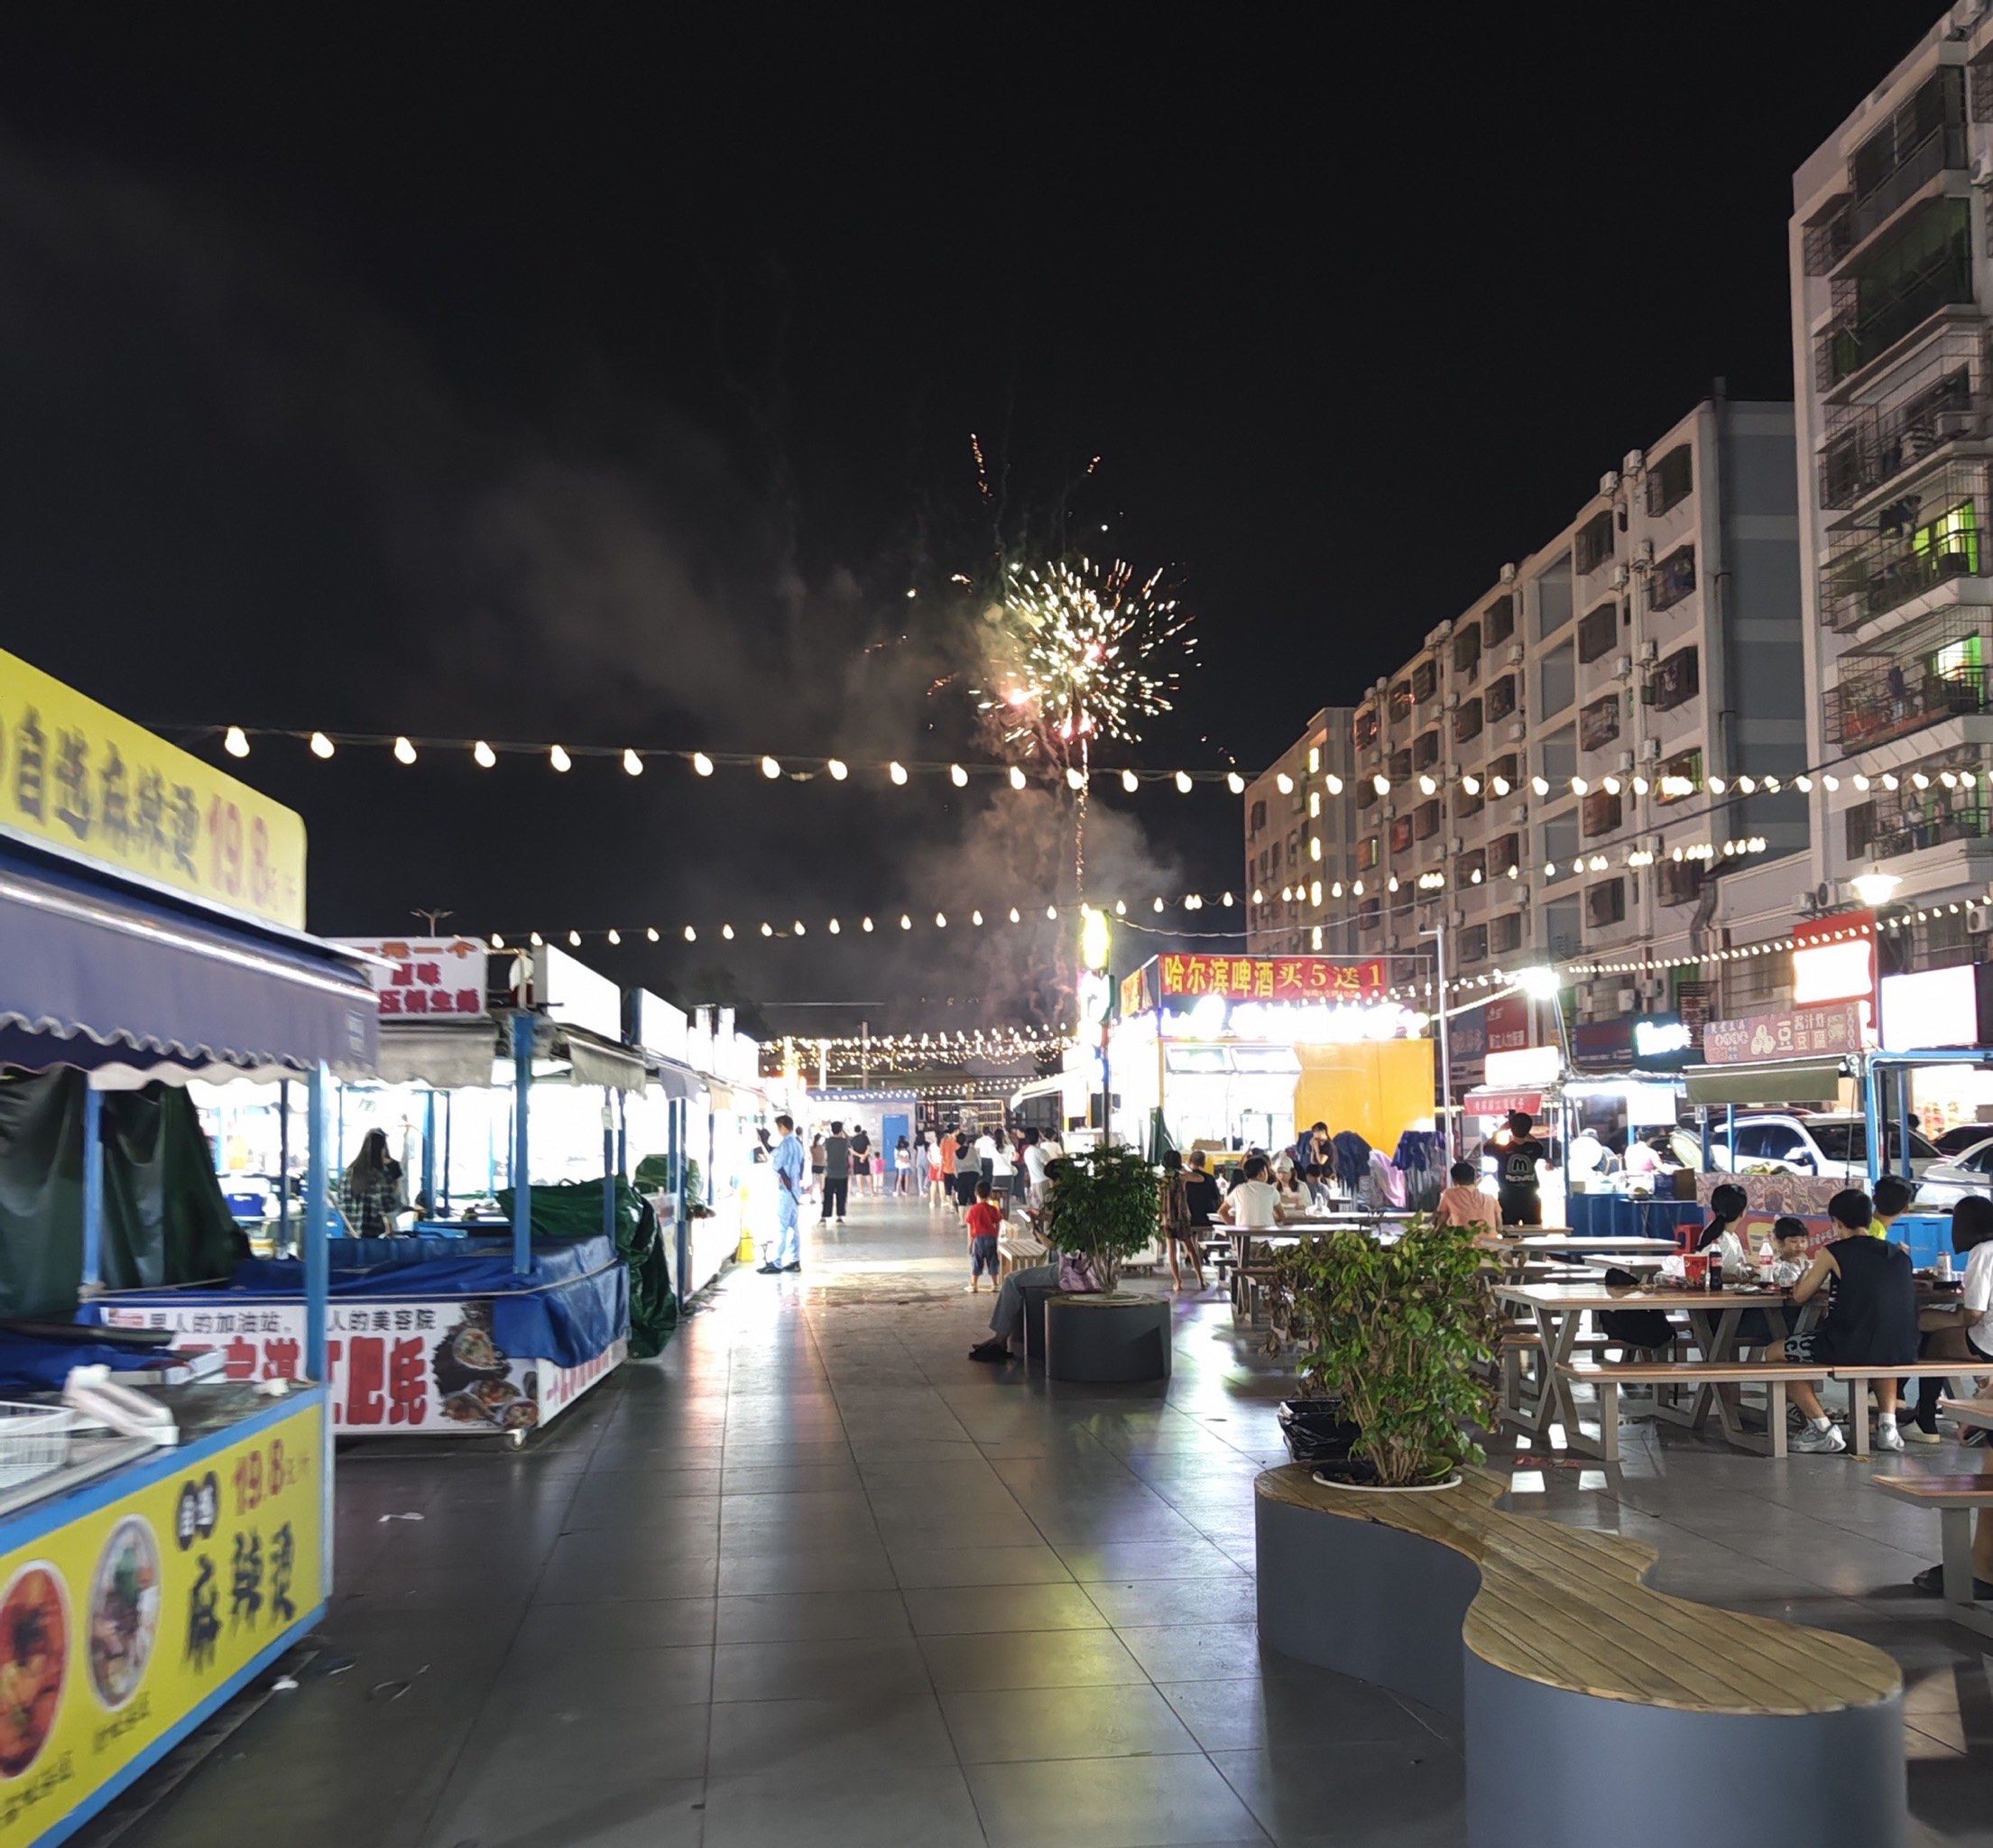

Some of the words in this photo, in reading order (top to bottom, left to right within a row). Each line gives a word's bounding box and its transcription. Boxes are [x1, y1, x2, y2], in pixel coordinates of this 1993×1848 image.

[326, 1309, 436, 1331] 人的美容院
